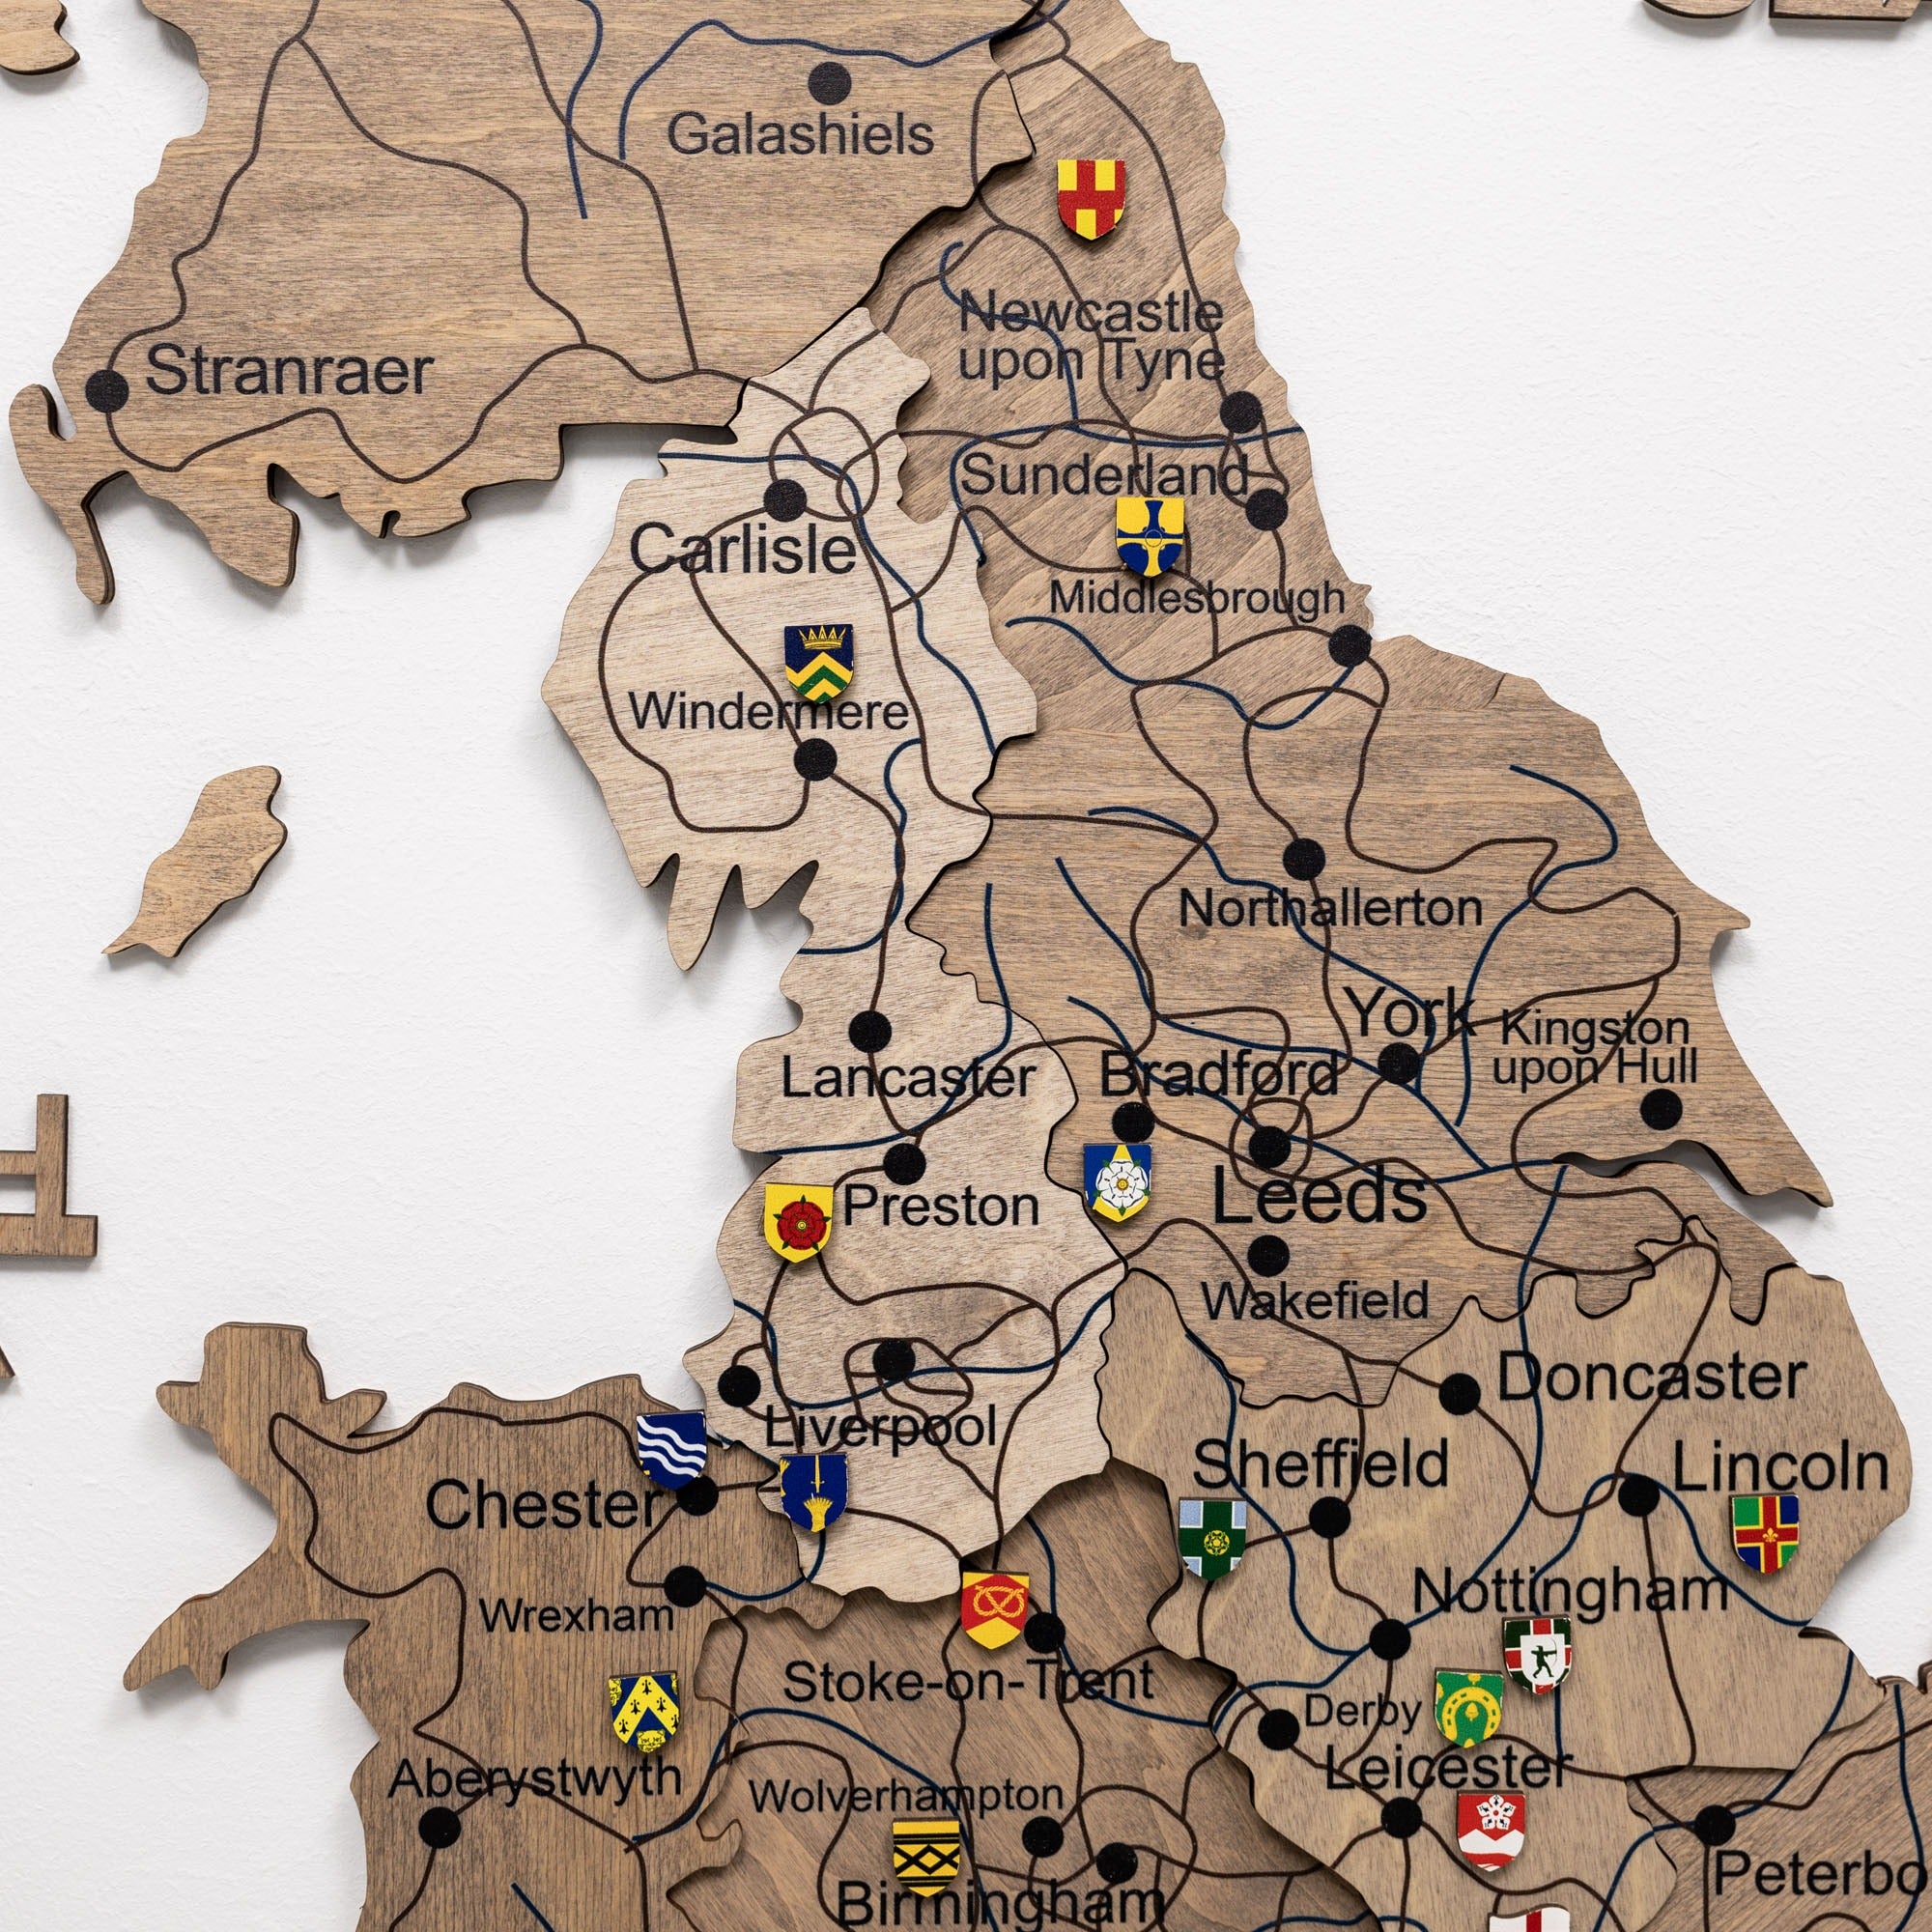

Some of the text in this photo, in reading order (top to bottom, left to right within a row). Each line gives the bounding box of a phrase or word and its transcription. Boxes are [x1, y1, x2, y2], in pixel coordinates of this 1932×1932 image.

[667, 110, 935, 156] Galashiels
[958, 290, 1225, 333] Newcastle
[146, 343, 435, 396] Stranraer
[958, 337, 1227, 391] upon Tyne
[961, 452, 1250, 497] Sunderland
[629, 522, 859, 575] Carlisle
[1049, 579, 1347, 623] Middlesbrough
[628, 691, 910, 731] Windermere
[1179, 887, 1484, 927] Northallerton
[1342, 984, 1477, 1038] York
[1500, 1009, 1690, 1052] Kingston
[782, 1054, 1037, 1099] Lancaster
[1100, 1049, 1340, 1097] Bradford
[1492, 1047, 1698, 1092] upon Hull
[843, 1182, 1039, 1227] Preston
[1213, 1165, 1429, 1225] Leeds
[1201, 1279, 1430, 1321] Wakefield
[1498, 1350, 1808, 1403] Doncaster
[767, 1405, 998, 1458] Liverpool
[1193, 1436, 1449, 1490] Sheffield
[1674, 1438, 1890, 1492] Lincoln
[426, 1478, 665, 1530] Chester
[479, 1597, 675, 1634] Wrexham
[1414, 1565, 1729, 1625] Nottingham
[783, 1658, 1155, 1703] Stoke-on-Trent
[1304, 1693, 1423, 1732] Derby
[388, 1756, 682, 1807] Aberystwyth
[1326, 1745, 1575, 1790] Leicester
[749, 1778, 1064, 1819] Wolverhampton
[1714, 1849, 1929, 1897] Peterbo
[838, 1880, 1165, 1932] Birmingham
